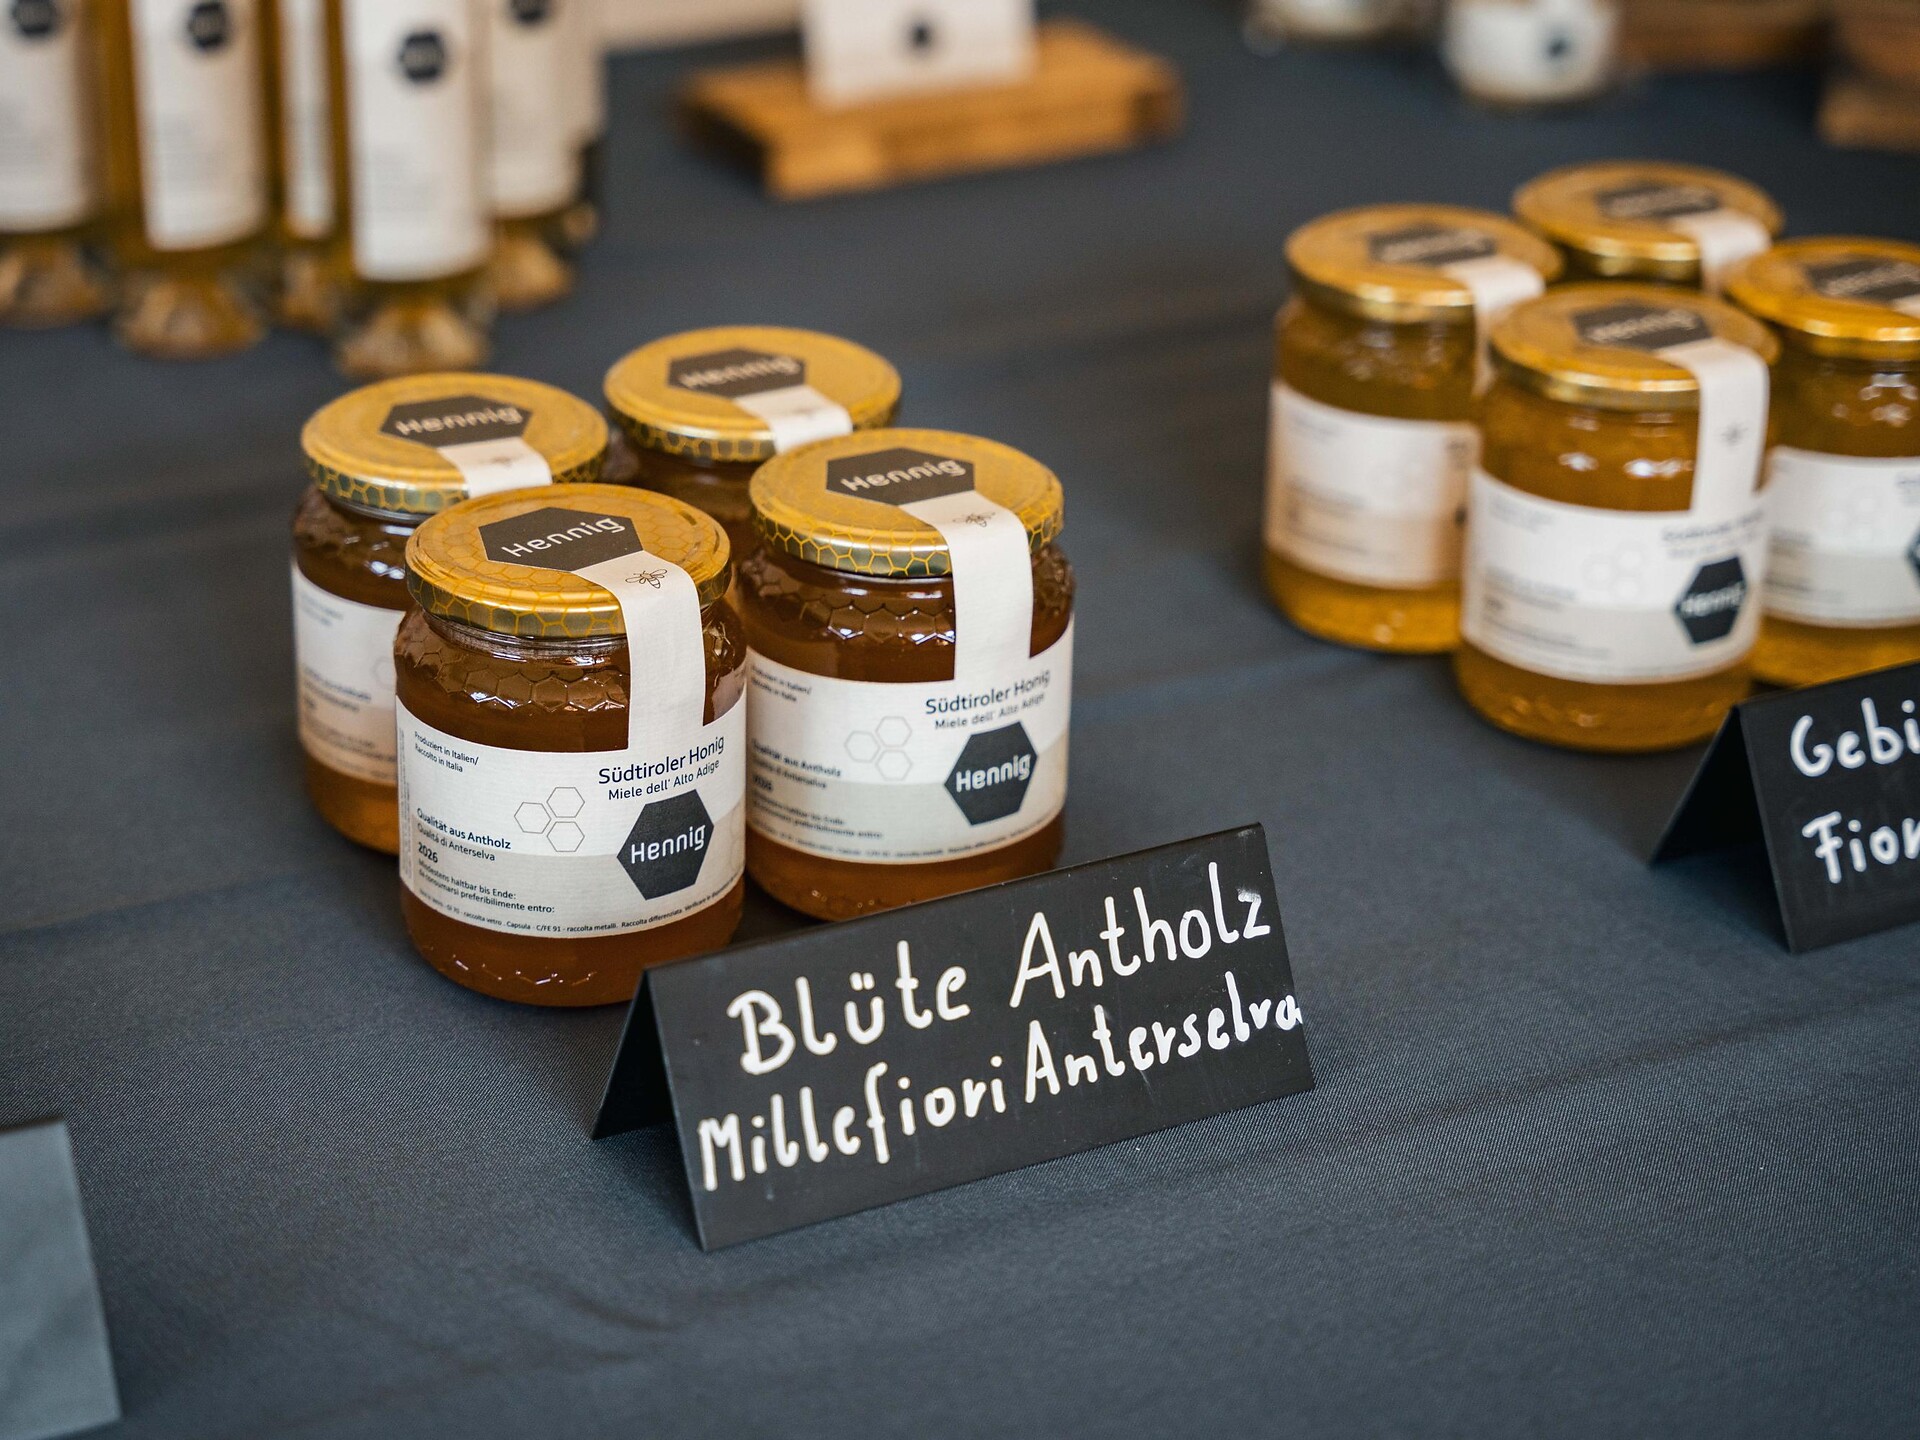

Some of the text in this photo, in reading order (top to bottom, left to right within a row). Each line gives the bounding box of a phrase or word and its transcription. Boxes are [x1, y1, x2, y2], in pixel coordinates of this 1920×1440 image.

[395, 404, 524, 436] Hennig
[839, 458, 968, 492] Hennig
[501, 516, 626, 558] Hennig
[925, 670, 1051, 715] Südtiroler Honig
[935, 717, 968, 730] Miele
[446, 761, 463, 773] Italia
[598, 756, 687, 785] Südtiroler
[689, 736, 725, 765] Honig
[956, 753, 1031, 793] Hennig
[608, 787, 643, 800] Miele
[673, 773, 694, 787] Alto
[696, 760, 720, 780] Adige
[417, 807, 512, 850] Qualität aus Antholz
[631, 824, 706, 864] Hennig
[418, 842, 439, 863] 2026
[449, 841, 496, 861] Anterselva
[450, 875, 478, 892] haltbar
[479, 884, 492, 896] bis
[492, 888, 517, 900] Ende:
[506, 921, 531, 931] Capsula
[536, 924, 552, 932] C/FE
[566, 924, 593, 932] raccolta
[621, 918, 647, 928] Raccolta
[527, 904, 555, 913] entro:
[727, 861, 1272, 1076] Blüte Antholz
[697, 970, 1303, 1191] Millefiori Anterselva
